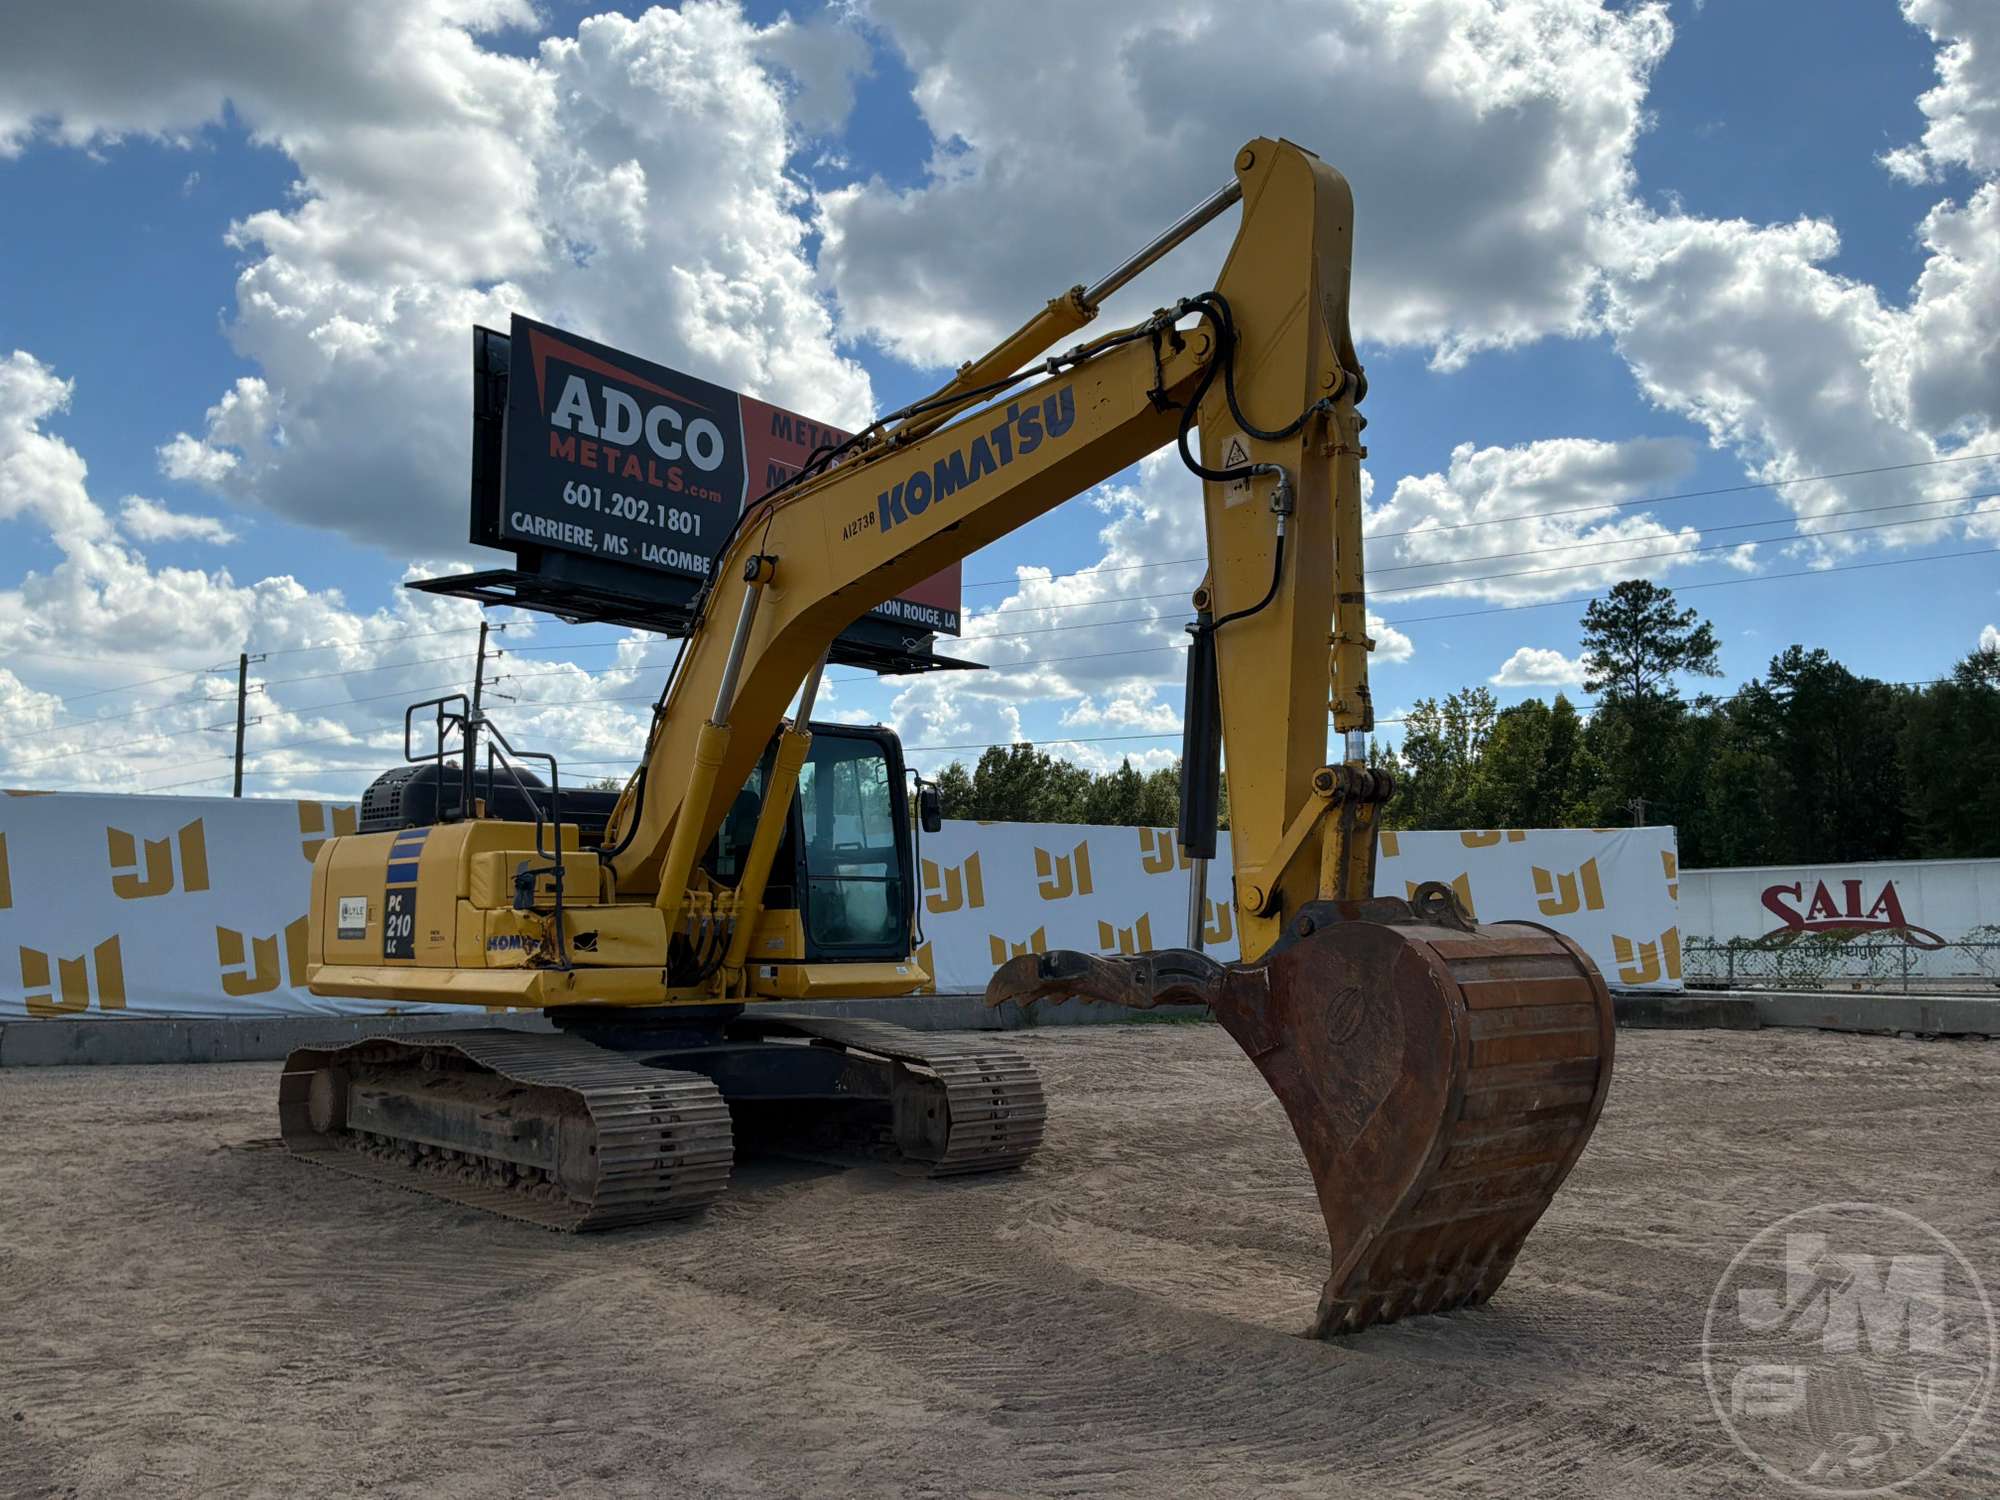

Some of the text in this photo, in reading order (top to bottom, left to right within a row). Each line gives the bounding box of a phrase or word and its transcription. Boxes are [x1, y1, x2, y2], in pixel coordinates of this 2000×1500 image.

[551, 375, 724, 472] ADCO
[877, 384, 1076, 534] KOMATSU
[562, 481, 701, 537] 601.202.1801
[511, 511, 710, 575] CARRIERE, MS LACOMBE
[904, 604, 942, 627] ROUGE,
[945, 612, 957, 629] LA
[386, 914, 411, 937] 210
[388, 895, 402, 912] PC
[1761, 879, 1906, 931] SAIA
[386, 940, 397, 955] LC
